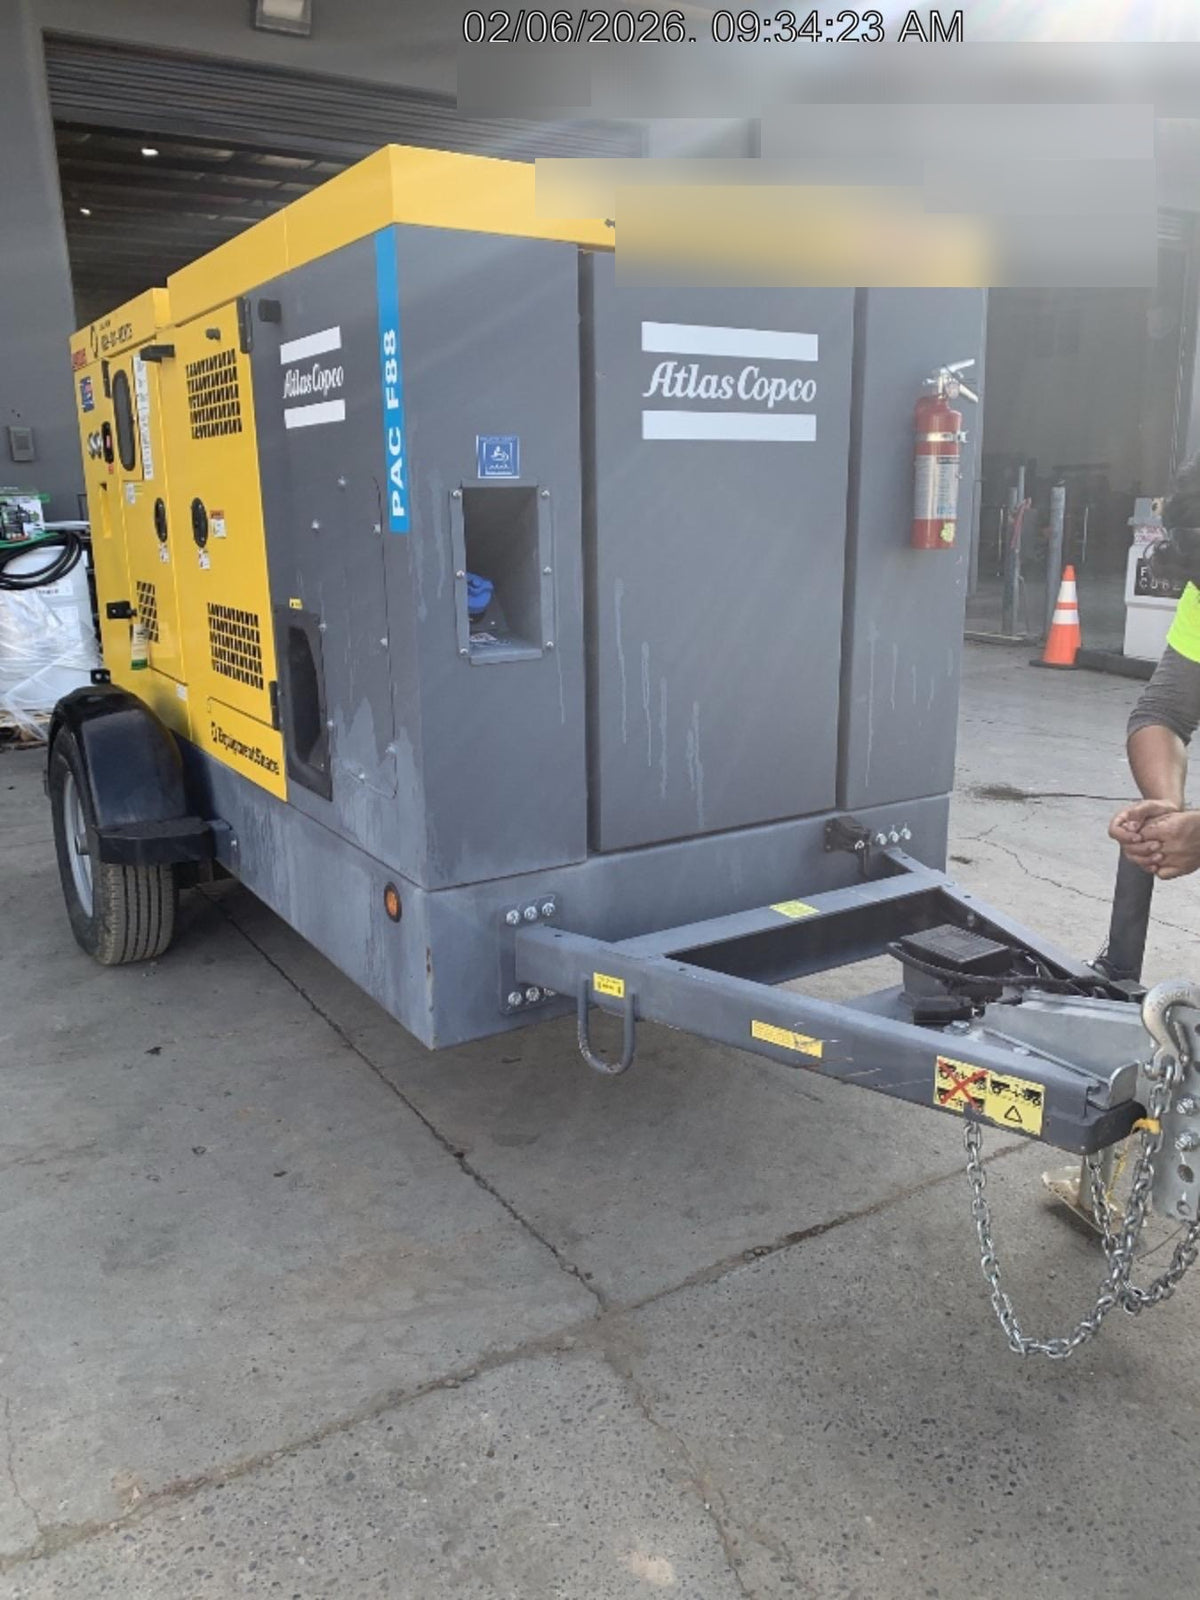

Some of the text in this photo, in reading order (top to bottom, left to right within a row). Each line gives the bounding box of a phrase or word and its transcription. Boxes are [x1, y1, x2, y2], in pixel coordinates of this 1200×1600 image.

[282, 363, 344, 399] Atlas Copco
[641, 360, 817, 409] Atlas Copco
[383, 328, 406, 518] PAC F88
